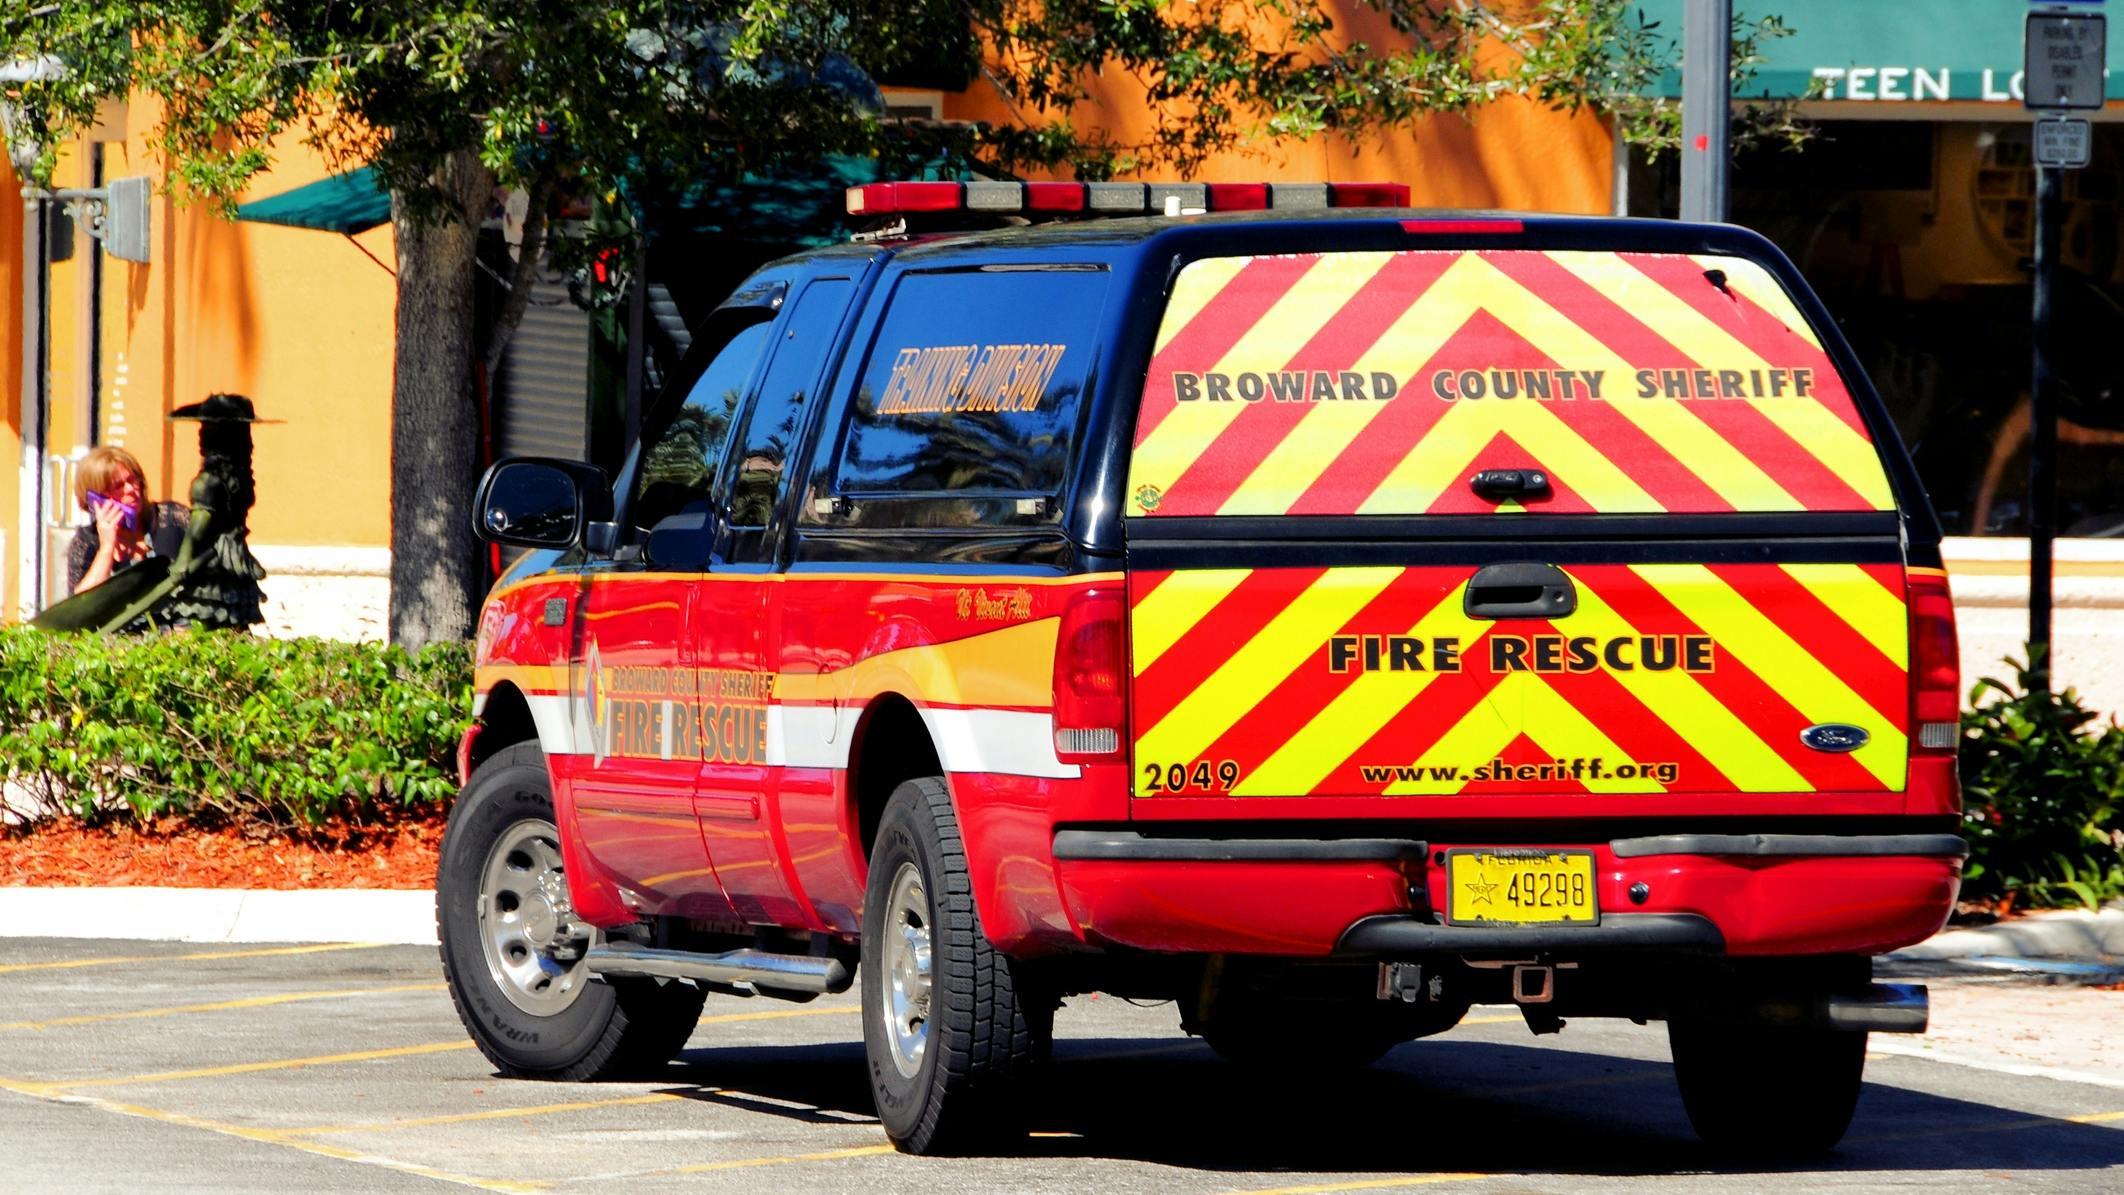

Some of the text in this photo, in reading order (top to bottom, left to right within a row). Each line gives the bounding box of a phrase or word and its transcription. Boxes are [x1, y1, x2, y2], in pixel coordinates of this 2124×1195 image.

[1812, 67, 1950, 100] TEEN
[955, 343, 1067, 413] DIVISION
[1172, 368, 1815, 403] BROWARD COUNTY SHERIFF
[1328, 634, 1715, 673] FIRE RESCUE
[611, 665, 669, 696] BROWARD
[720, 669, 777, 699] SHERIFF
[610, 698, 768, 766] FIRE RESCUE
[1143, 760, 1240, 793] 2049
[1359, 757, 1679, 784] www.sheriff.org
[1507, 873, 1584, 907] 49298
